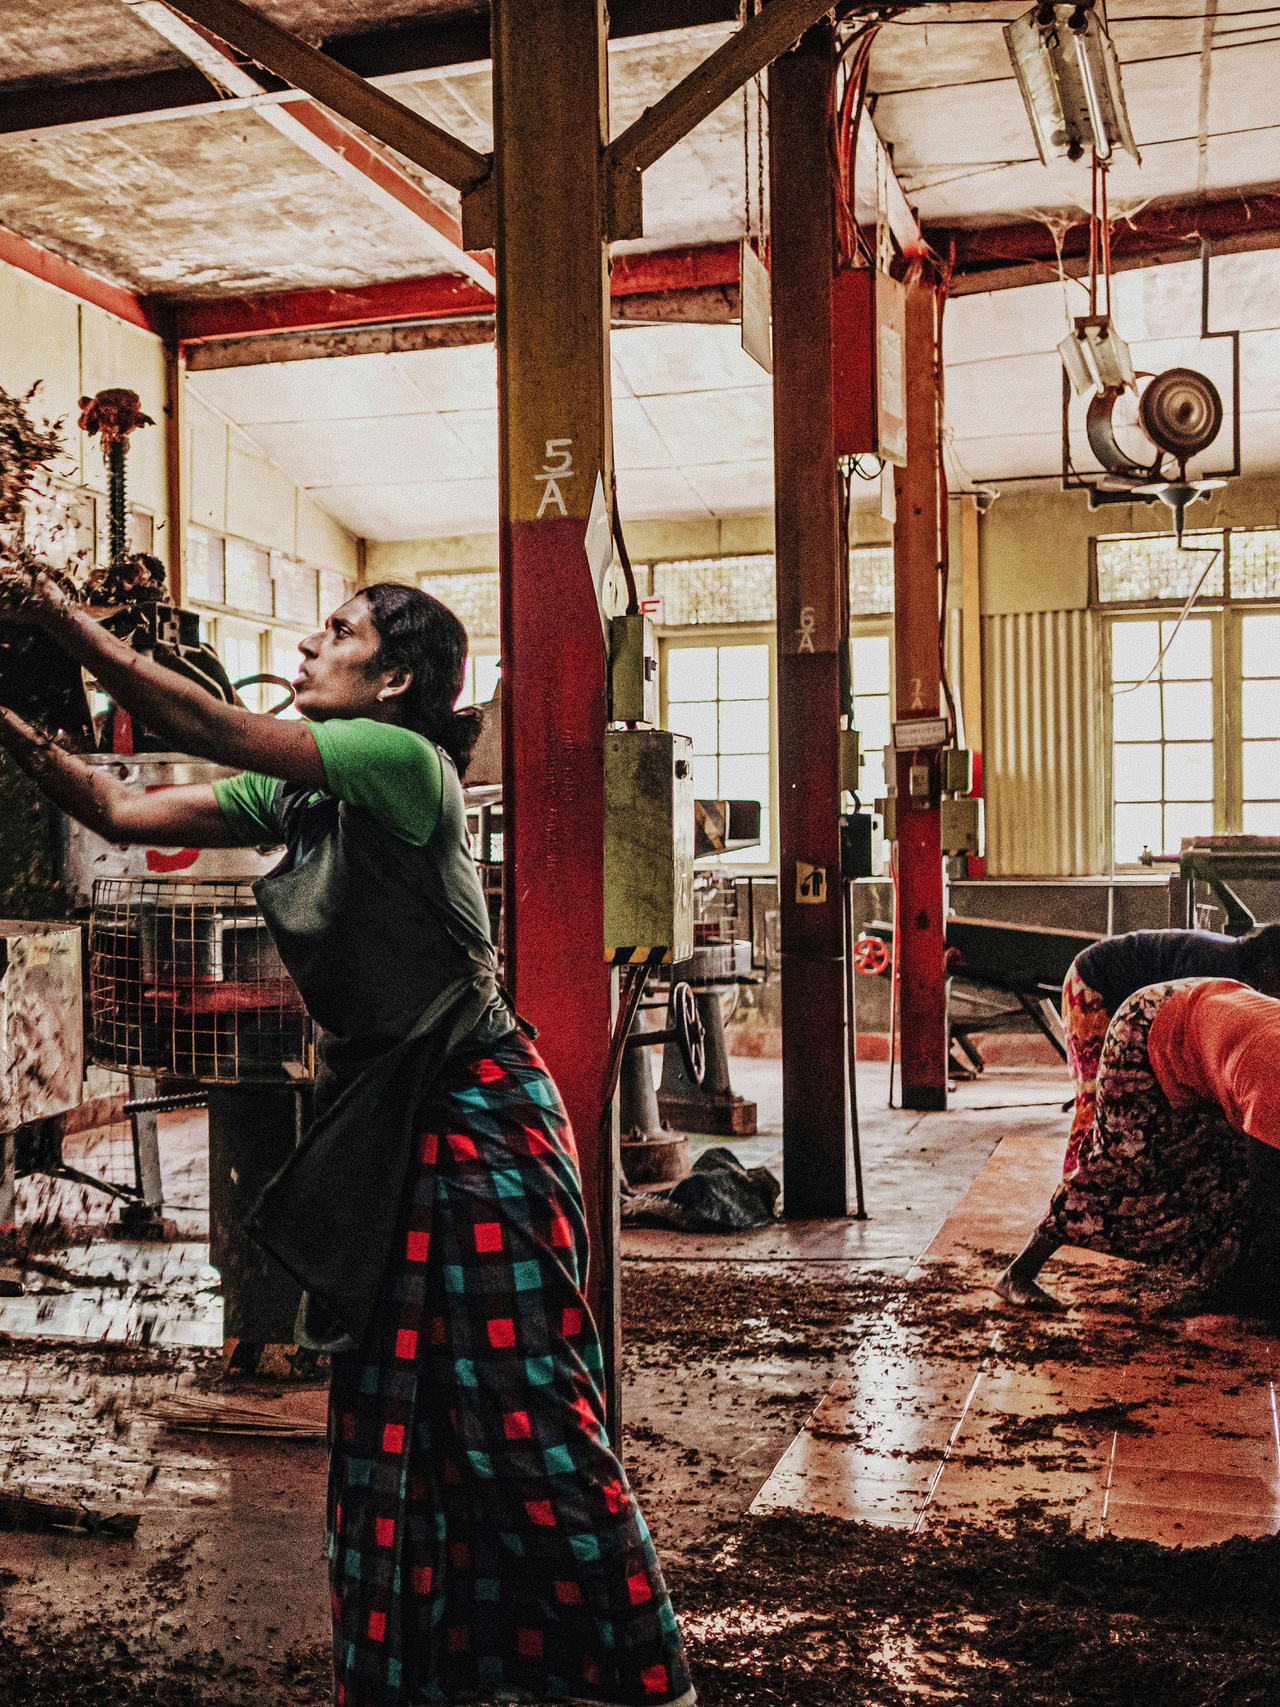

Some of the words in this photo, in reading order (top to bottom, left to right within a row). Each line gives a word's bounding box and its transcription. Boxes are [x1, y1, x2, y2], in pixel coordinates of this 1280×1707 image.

[542, 438, 573, 473] 5
[536, 477, 568, 518] A
[800, 606, 815, 630] 6
[797, 631, 815, 654] A
